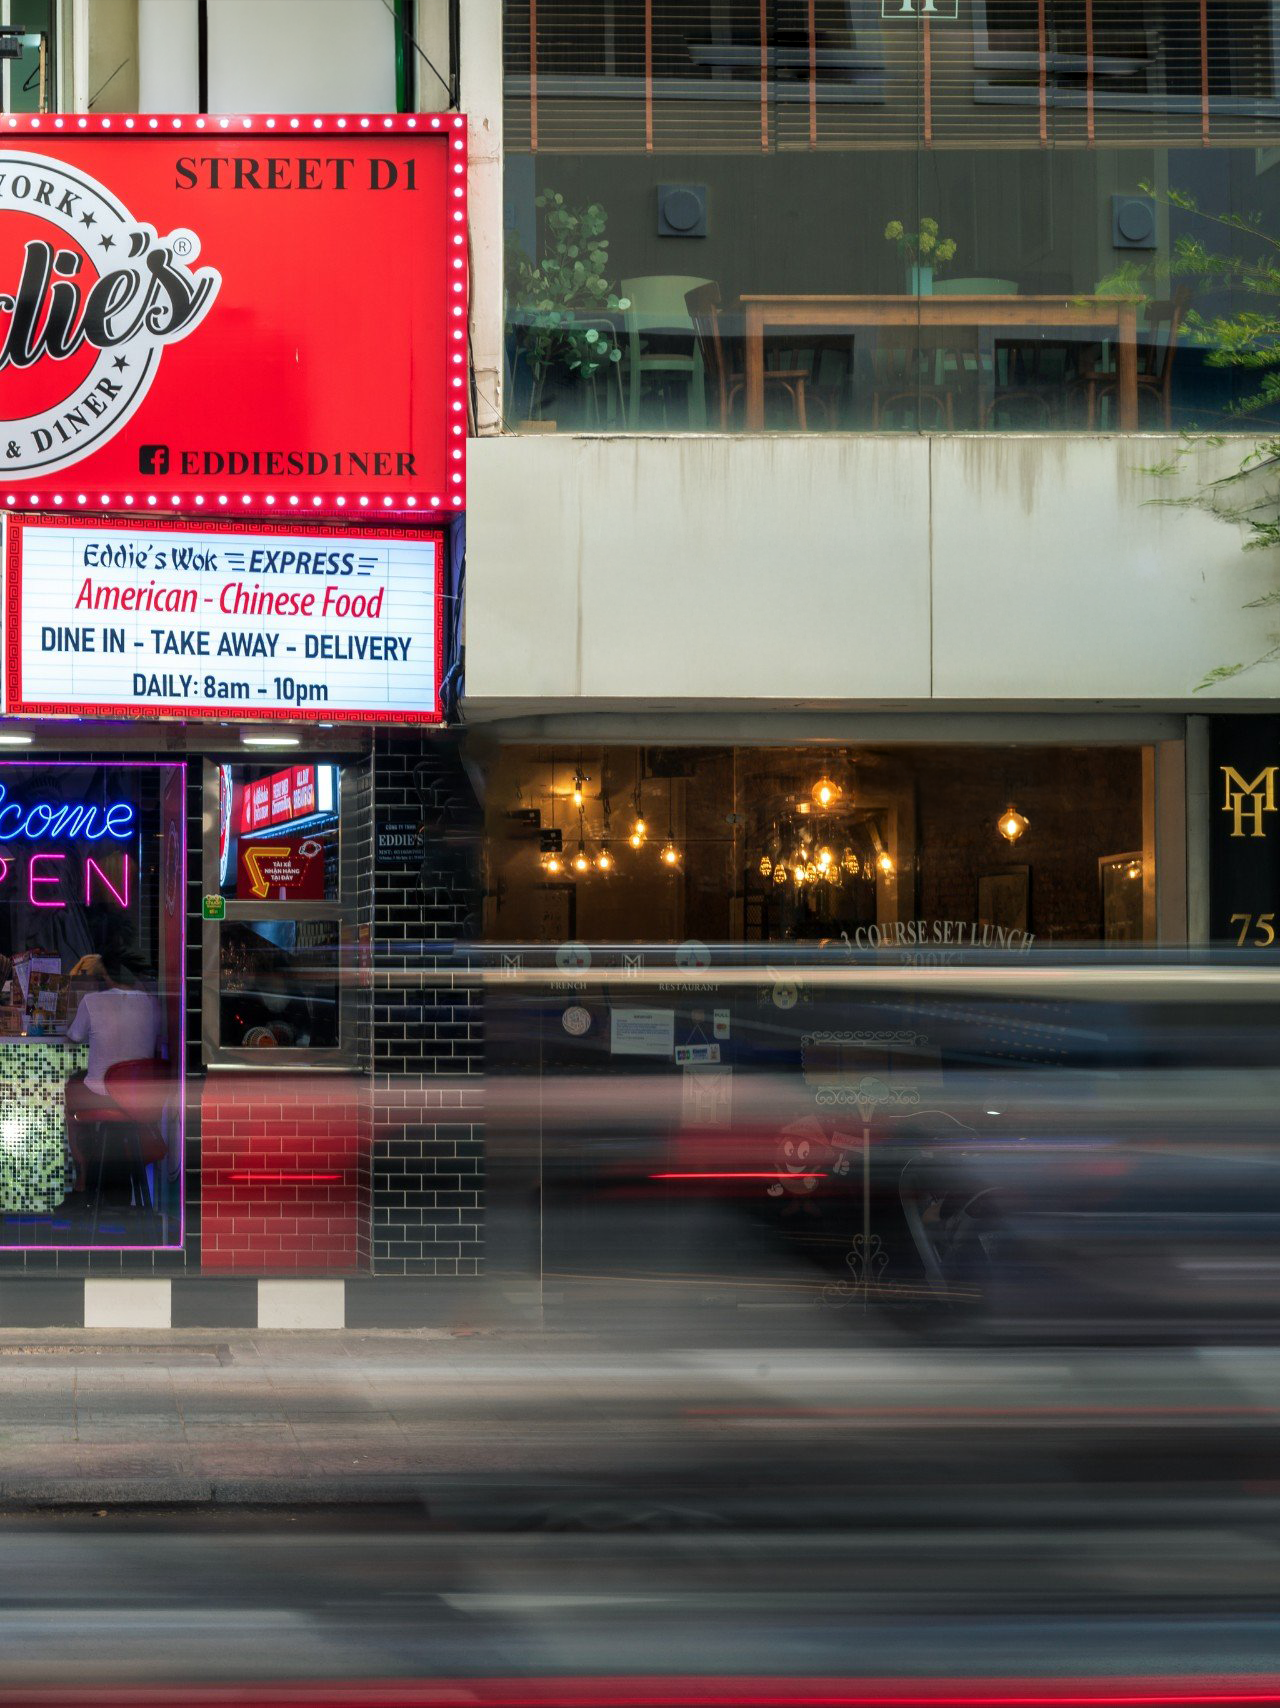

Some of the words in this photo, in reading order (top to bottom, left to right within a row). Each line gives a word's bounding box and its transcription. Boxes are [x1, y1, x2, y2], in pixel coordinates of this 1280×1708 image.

[175, 157, 355, 191] STREET
[369, 158, 420, 191] D1
[5, 440, 21, 458] &
[179, 451, 419, 477] EDDIESD1NER
[83, 543, 167, 570] Eddie's
[172, 548, 218, 572] Wok
[248, 550, 355, 577] EXPRESS
[75, 578, 198, 613] American
[219, 582, 315, 617] Chinese
[321, 585, 385, 618] Food
[41, 627, 95, 653] DINE
[102, 628, 125, 653] IN
[150, 629, 211, 656] TAKE
[216, 631, 280, 658] AWAY
[304, 634, 413, 662] DELIVERY
[132, 673, 199, 697] DAILY:
[203, 675, 250, 699] 8am
[274, 677, 329, 706] 10pm
[378, 834, 424, 846] EDDIE'S
[840, 930, 852, 954] 3
[855, 920, 929, 951] COURSE
[933, 919, 966, 945] SET
[970, 922, 1036, 956] LUNCH
[1230, 913, 1275, 947] 75
[550, 981, 587, 990] FRENCH
[659, 983, 720, 991] RESTAURANT
